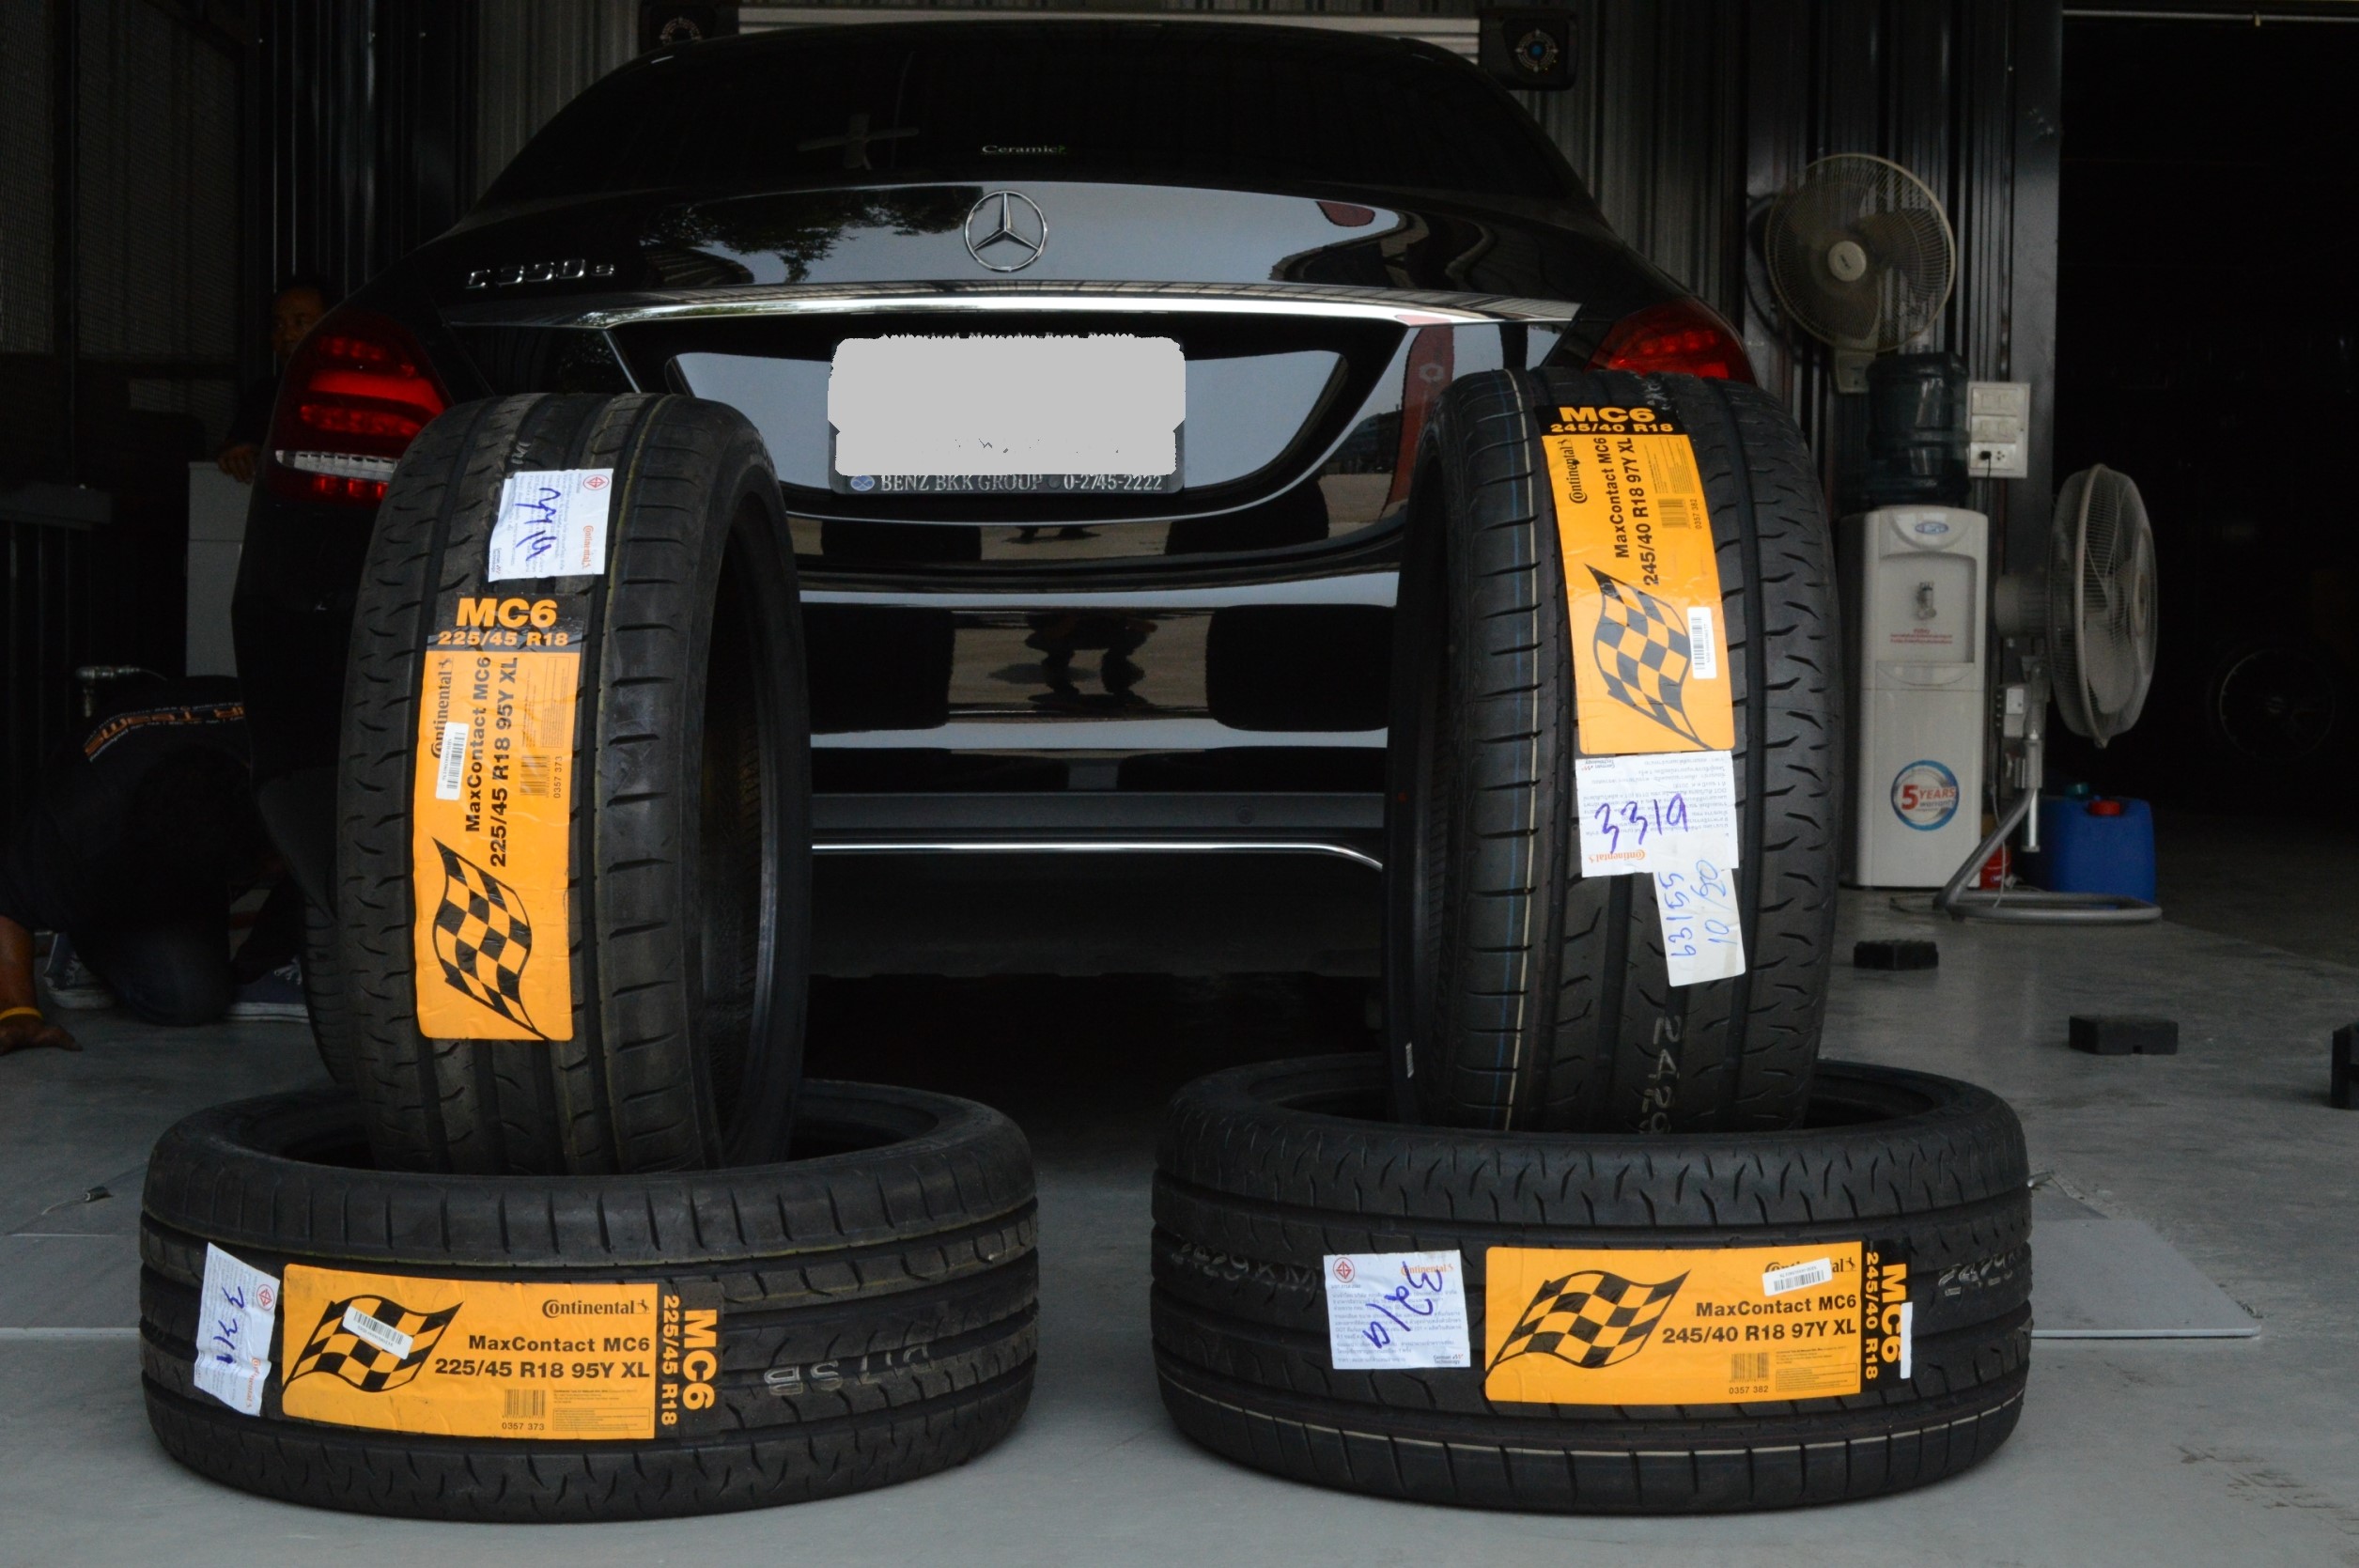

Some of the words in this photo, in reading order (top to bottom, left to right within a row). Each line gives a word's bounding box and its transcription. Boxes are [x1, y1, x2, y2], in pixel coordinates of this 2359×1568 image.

[1550, 423, 1625, 432] 245/40
[1633, 423, 1674, 432] R18
[1559, 407, 1656, 423] MC6
[1593, 437, 1613, 464] MC6
[1616, 437, 1636, 455] XL
[880, 474, 930, 491] BENZ
[935, 474, 973, 490] BKK
[977, 474, 1043, 490] GROUP
[1563, 445, 1588, 505] Continental
[1622, 457, 1642, 483] 97Y
[1601, 467, 1630, 559] MaxContact
[1628, 487, 1649, 519] R18
[1635, 523, 1660, 586] 245/40
[456, 597, 558, 628] MC6
[437, 630, 519, 646] 225/45
[526, 630, 568, 646] R18
[473, 656, 491, 701] MC6
[500, 657, 519, 685] XL
[496, 691, 515, 729] 95Y
[466, 706, 487, 832] MaxContact
[492, 734, 511, 781] R18
[553, 775, 562, 799] 0357
[1901, 784, 1919, 811] 5
[1919, 787, 1956, 800] YEARS
[490, 787, 508, 867] 225/45
[1595, 849, 1646, 862] Continental
[1864, 1251, 1879, 1330] 245/40
[541, 1298, 635, 1319] Continental
[1695, 1299, 1815, 1318] MaxContact
[1818, 1294, 1856, 1312] MC6
[1881, 1263, 1907, 1363] MC6
[468, 1334, 596, 1353] MaxContact
[602, 1336, 650, 1352] MC6
[661, 1295, 680, 1375] 225/45
[1661, 1326, 1739, 1344] 245/40
[1745, 1324, 1785, 1342] R18
[1791, 1320, 1828, 1338] 97Y
[1833, 1318, 1856, 1335] XL
[434, 1358, 513, 1377] 225/45
[520, 1361, 565, 1379] R18
[571, 1361, 617, 1379] 95Y
[621, 1361, 650, 1378] XL
[682, 1309, 718, 1411] MC6
[1865, 1337, 1878, 1380] R18
[1729, 1386, 1749, 1394] 0357
[1753, 1385, 1769, 1394] 382
[660, 1383, 679, 1426] R18
[502, 1421, 524, 1431] 0357
[527, 1421, 545, 1431] 373
